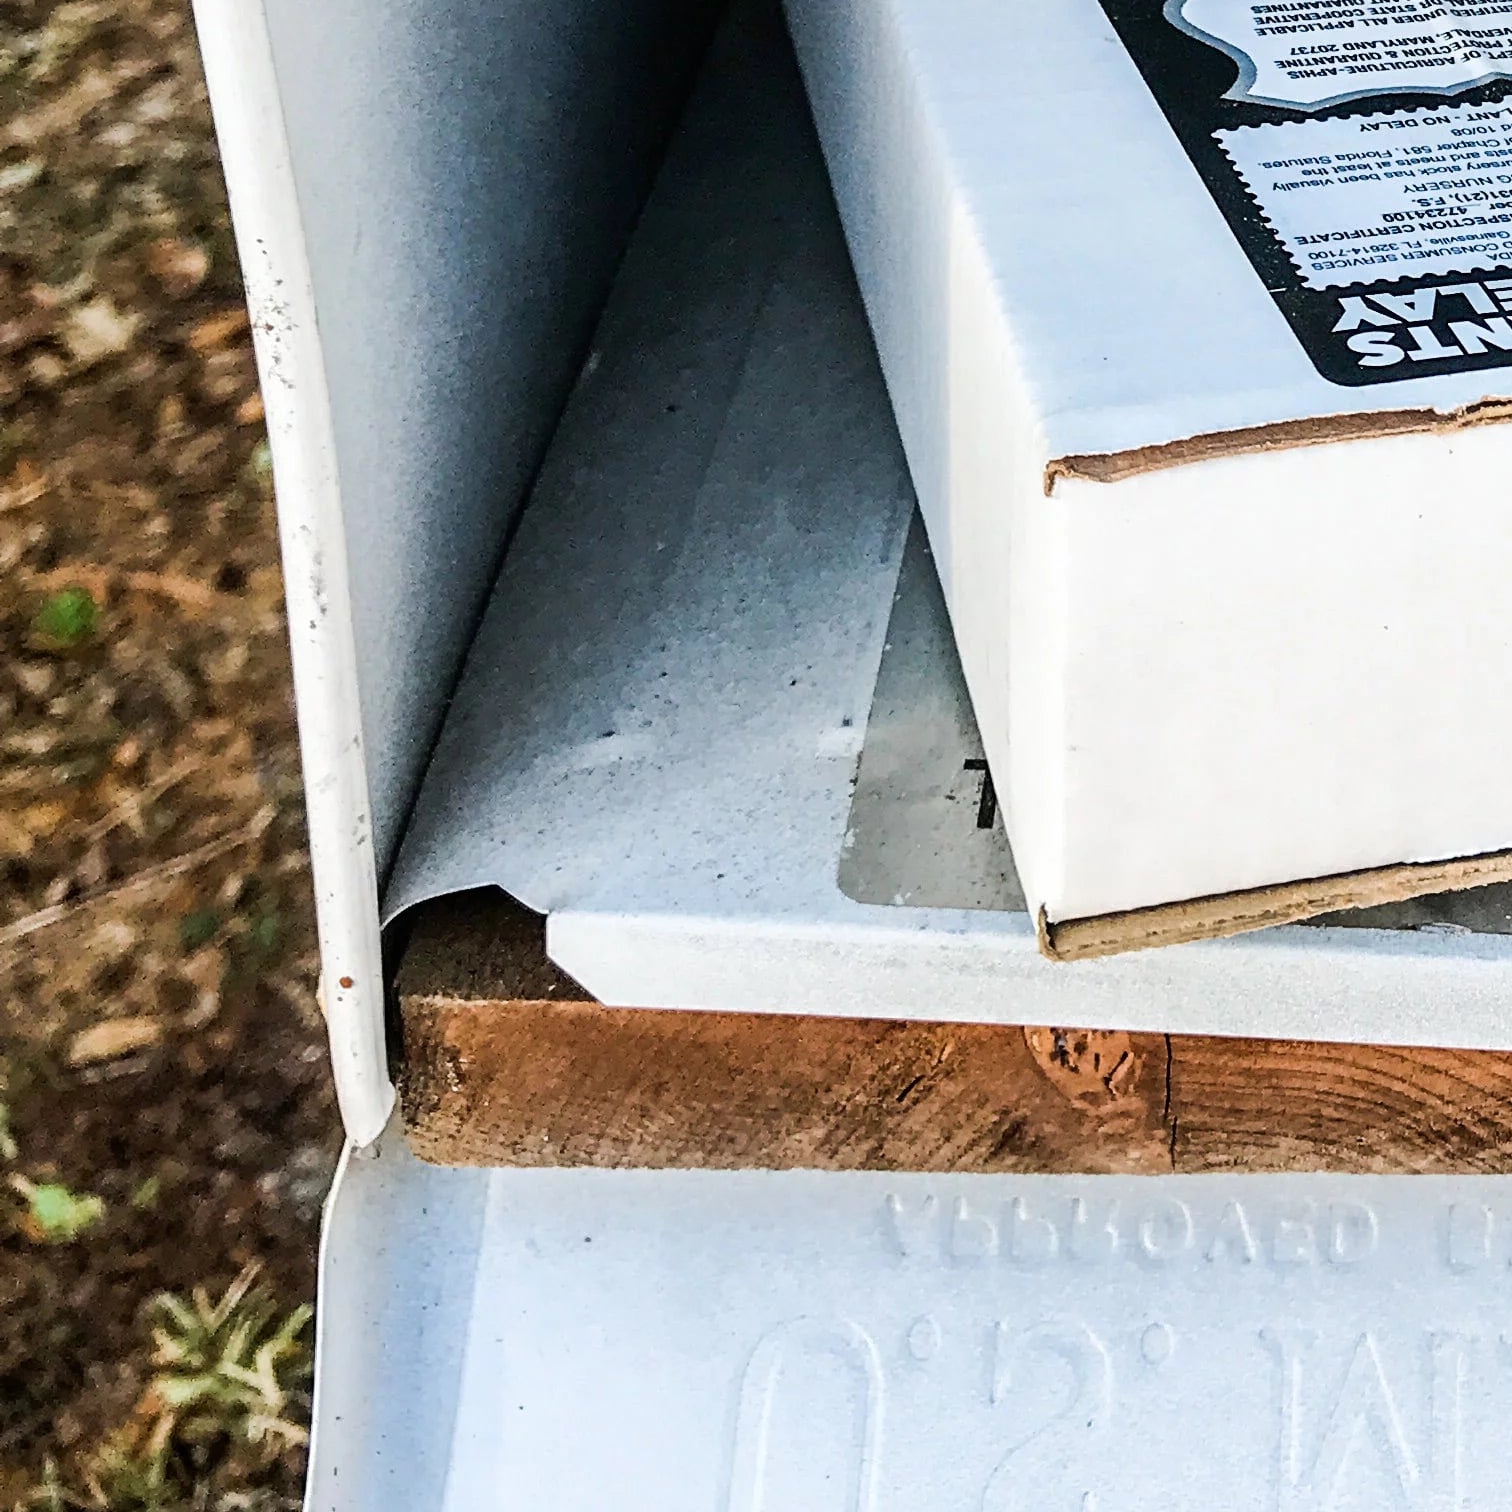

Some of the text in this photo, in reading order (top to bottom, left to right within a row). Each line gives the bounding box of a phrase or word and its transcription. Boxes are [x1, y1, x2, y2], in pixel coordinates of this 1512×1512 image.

[1367, 4, 1417, 15] STATE
[1391, 7, 1447, 24] UNDER
[1253, 8, 1365, 26] COOPERATIVE
[1357, 17, 1388, 27] ALL
[1253, 19, 1355, 37] APPLICABLE
[1289, 43, 1339, 56] 20737
[1342, 35, 1435, 51] MARYLAND
[1401, 39, 1501, 56] PROTECTION
[1273, 51, 1382, 69] QUARANTINE
[1384, 50, 1397, 59] &
[1460, 50, 1481, 62] OF
[1286, 56, 1456, 79] AGRICULTURE-APHIS
[1358, 118, 1418, 132] DELAY
[1421, 114, 1451, 126] NO
[1436, 136, 1501, 152] Chapter
[1334, 148, 1391, 163] Florida
[1394, 155, 1446, 167] meets
[1449, 150, 1480, 162] and
[1332, 162, 1372, 174] least
[1374, 160, 1391, 169] at
[1301, 167, 1329, 179] the
[1383, 169, 1415, 181] has
[1417, 165, 1461, 178] stock
[1272, 176, 1335, 193] visually
[1337, 173, 1380, 186] been
[1401, 176, 1493, 194] NURSERY
[1411, 197, 1446, 208] F.S.
[1293, 223, 1415, 246] CERTIFICATE
[1399, 239, 1422, 251] FL
[1401, 242, 1498, 260] CONSUMER
[1311, 254, 1397, 271] SERVICES
